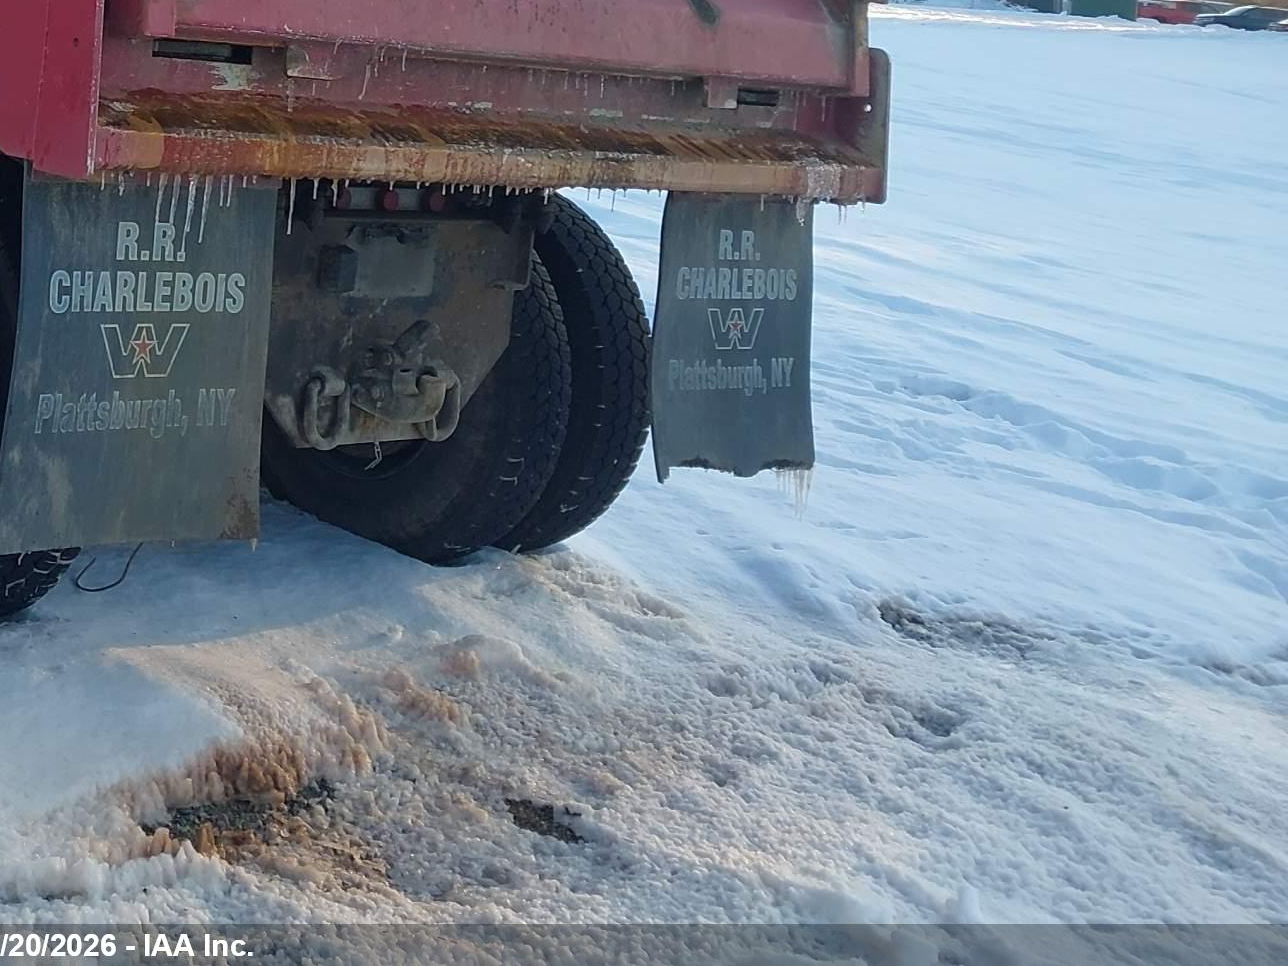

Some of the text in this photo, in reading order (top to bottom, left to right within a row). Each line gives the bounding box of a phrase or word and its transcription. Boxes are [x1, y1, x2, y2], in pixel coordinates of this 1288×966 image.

[115, 221, 187, 262] R.R.
[718, 229, 761, 261] R.R.
[49, 270, 246, 314] CHARLEBOIS
[676, 266, 798, 301] CHARLEBOIS
[668, 357, 795, 396] Plattsburgh, NY
[34, 387, 235, 438] Plattsburgh, NY
